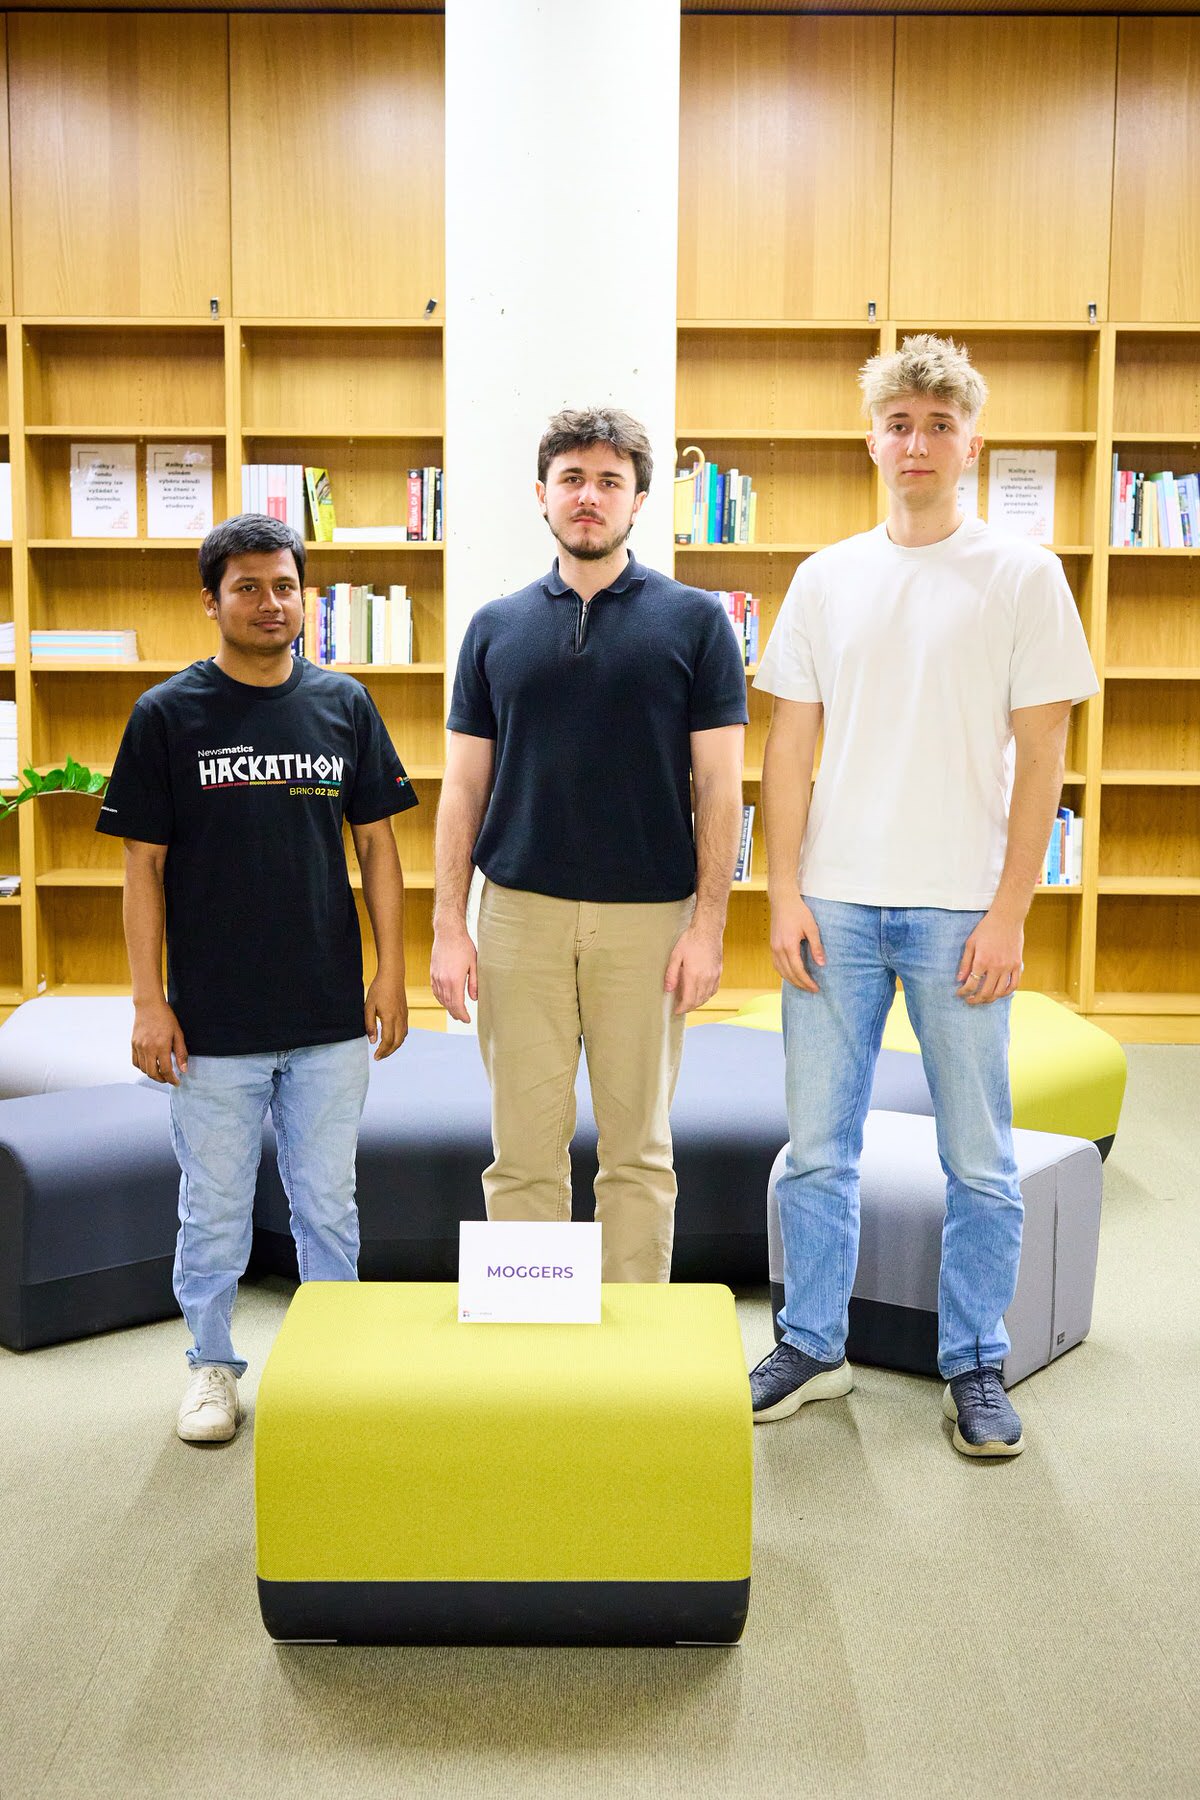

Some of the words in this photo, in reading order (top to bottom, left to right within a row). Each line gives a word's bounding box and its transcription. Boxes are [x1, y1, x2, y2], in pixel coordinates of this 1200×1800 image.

[197, 745, 254, 758] Newsmatics
[198, 753, 344, 786] HACKATHON
[289, 787, 314, 796] BRNO
[315, 787, 326, 796] 02
[487, 1265, 574, 1279] MOGGERS
